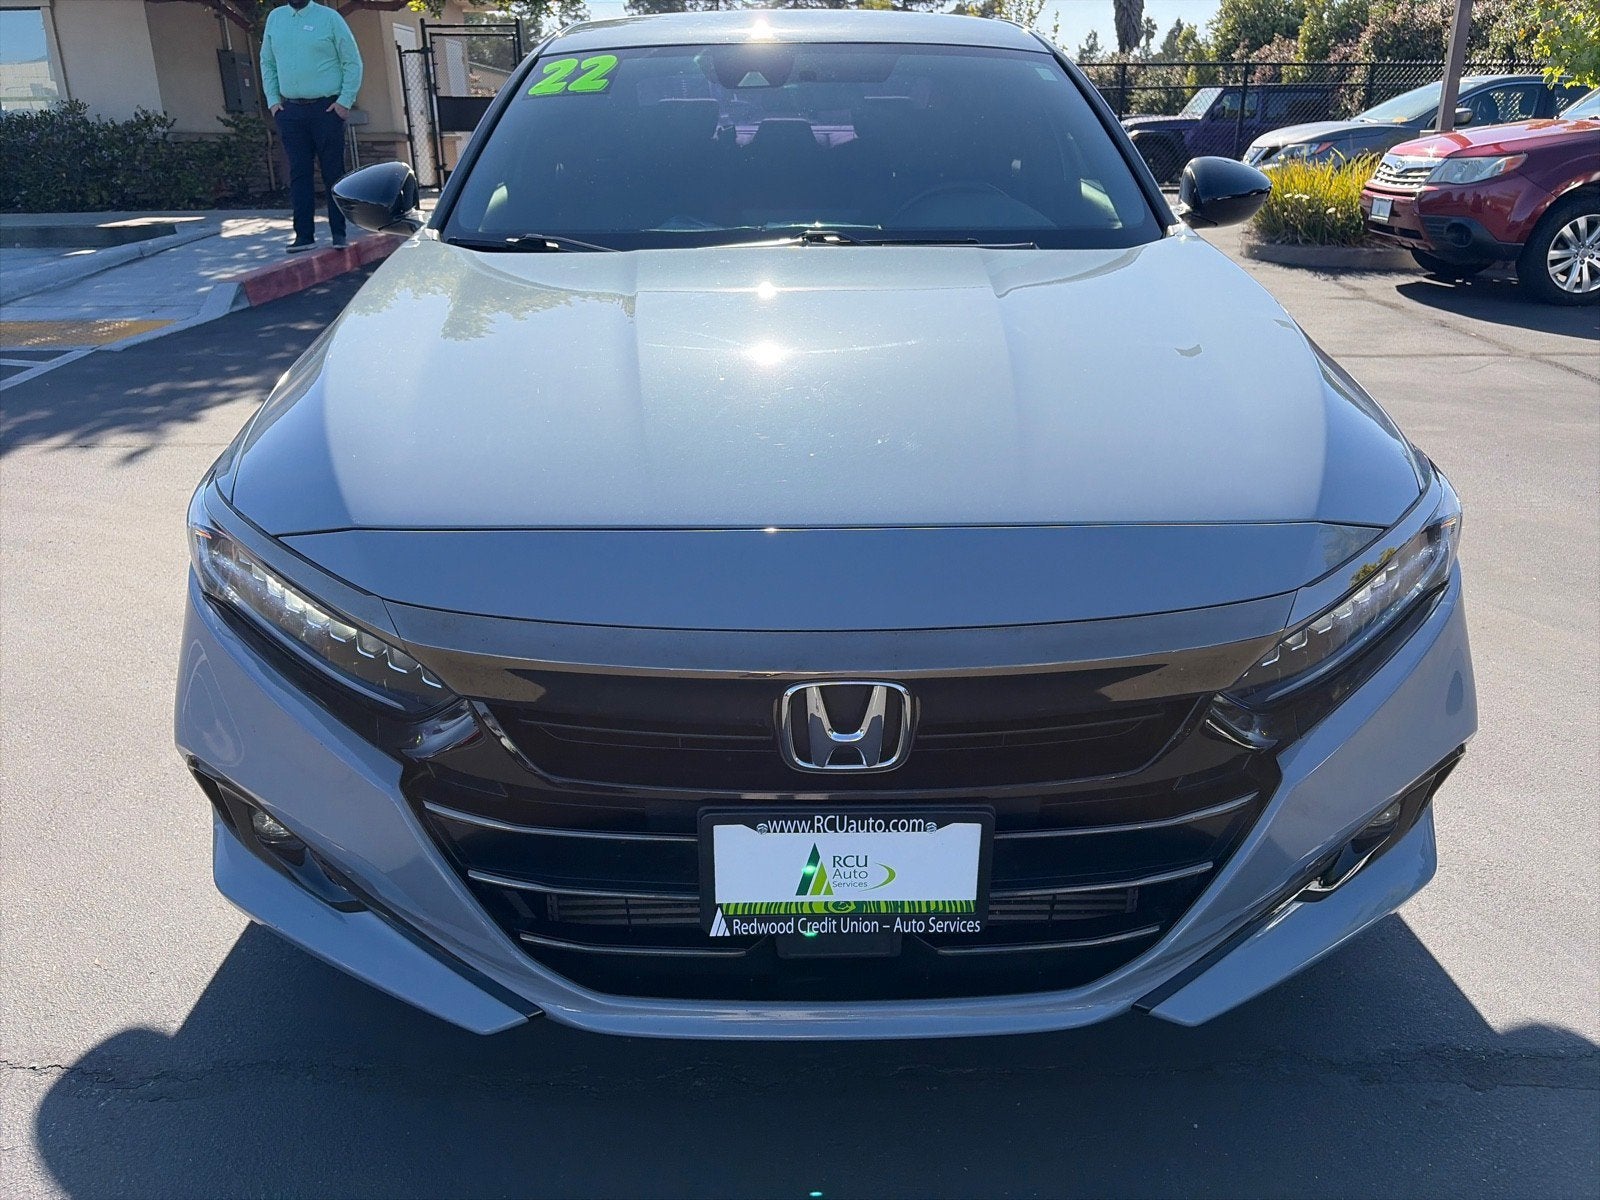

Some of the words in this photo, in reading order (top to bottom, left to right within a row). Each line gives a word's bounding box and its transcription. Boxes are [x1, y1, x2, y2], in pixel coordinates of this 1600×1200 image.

[528, 55, 618, 96] 22
[767, 815, 925, 833] www.RCUauto.com
[832, 855, 868, 868] RCU
[832, 868, 868, 880] Auto
[832, 880, 868, 888] Services
[733, 918, 794, 935] Redwood
[798, 917, 837, 934] Credit
[840, 917, 879, 933] Union
[893, 917, 926, 933] Auto
[928, 916, 981, 933] Services
